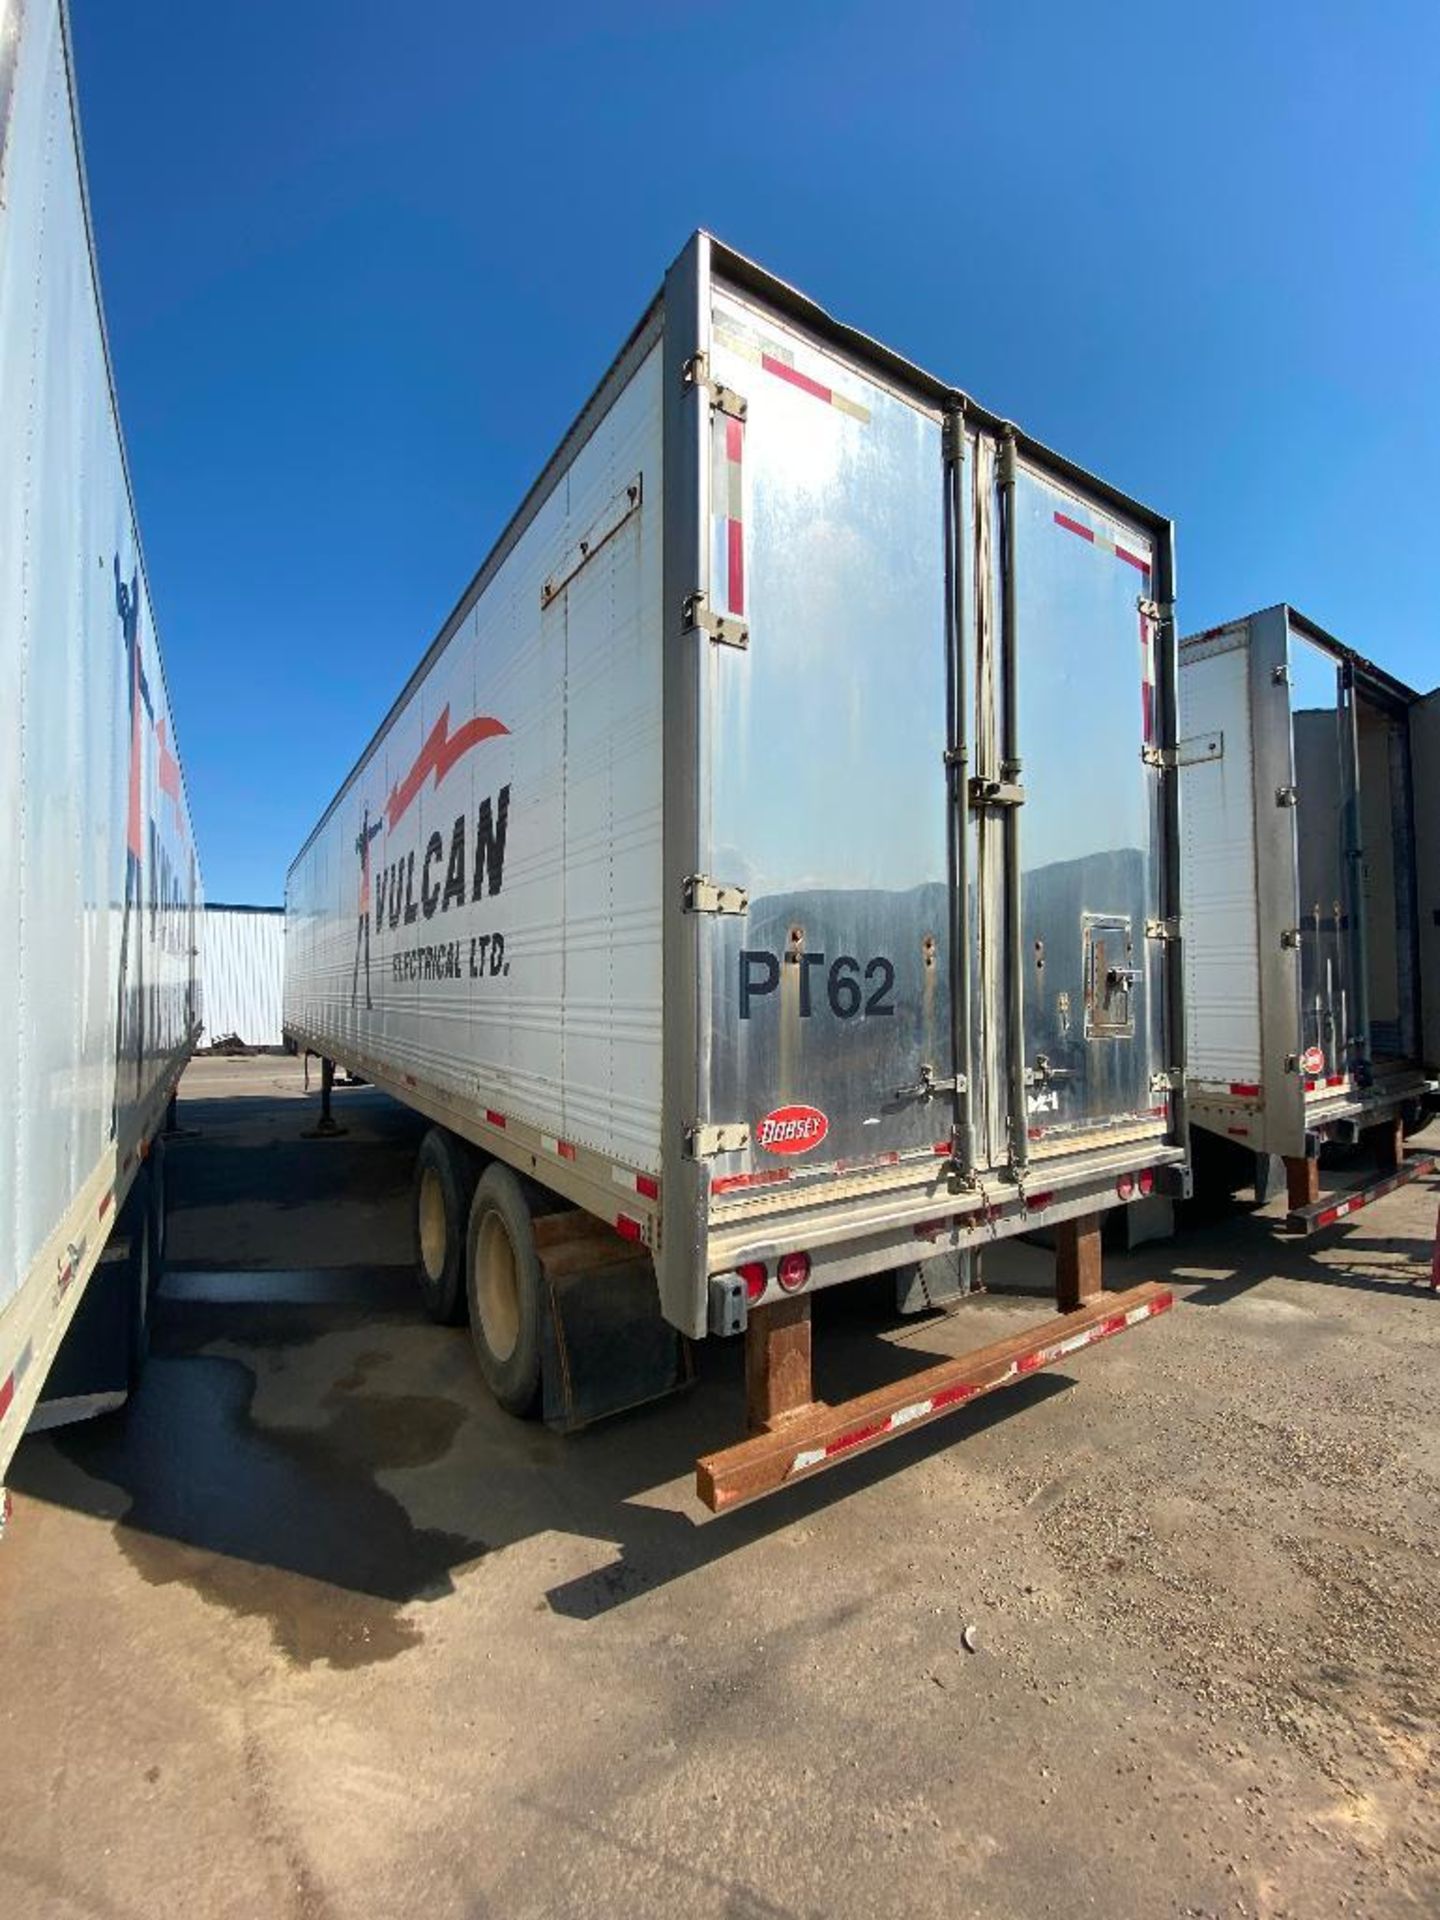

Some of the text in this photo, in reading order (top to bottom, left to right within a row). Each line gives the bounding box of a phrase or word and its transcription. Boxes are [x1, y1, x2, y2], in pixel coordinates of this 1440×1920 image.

[376, 783, 511, 934] VULCAN
[392, 932, 510, 982] ELECTRICAL LTD.
[739, 950, 894, 1019] PT62
[760, 1117, 821, 1145] DORSEY
